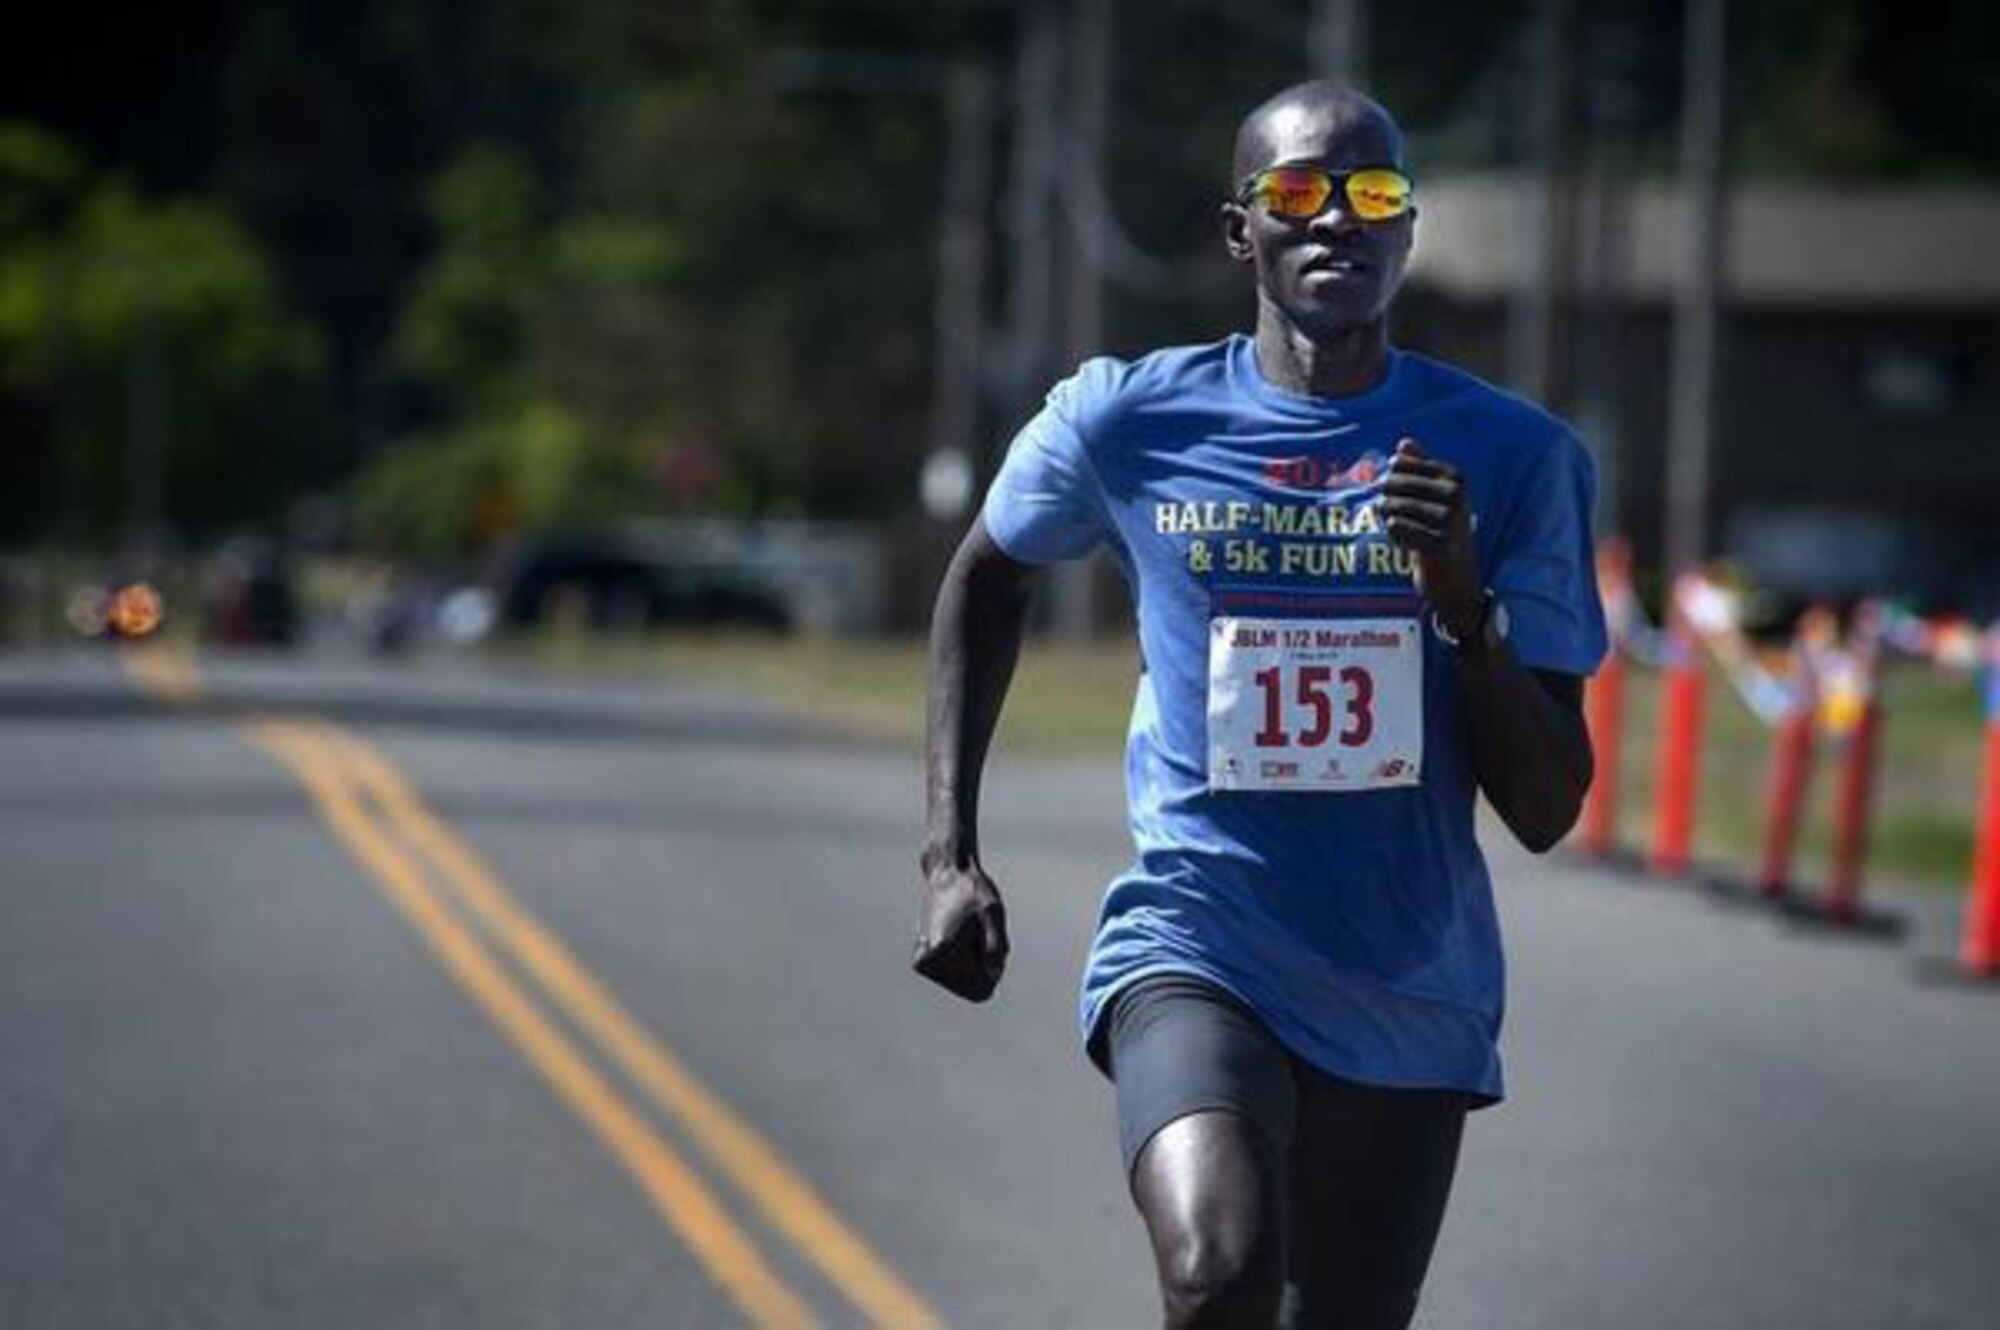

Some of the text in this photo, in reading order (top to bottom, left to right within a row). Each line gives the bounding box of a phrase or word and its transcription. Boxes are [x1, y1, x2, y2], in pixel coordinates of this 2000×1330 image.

[1188, 540, 1416, 577] & 5k FUN RU
[1231, 630, 1401, 648] JBLM 1/2 Marathon
[1254, 665, 1374, 748] 153
